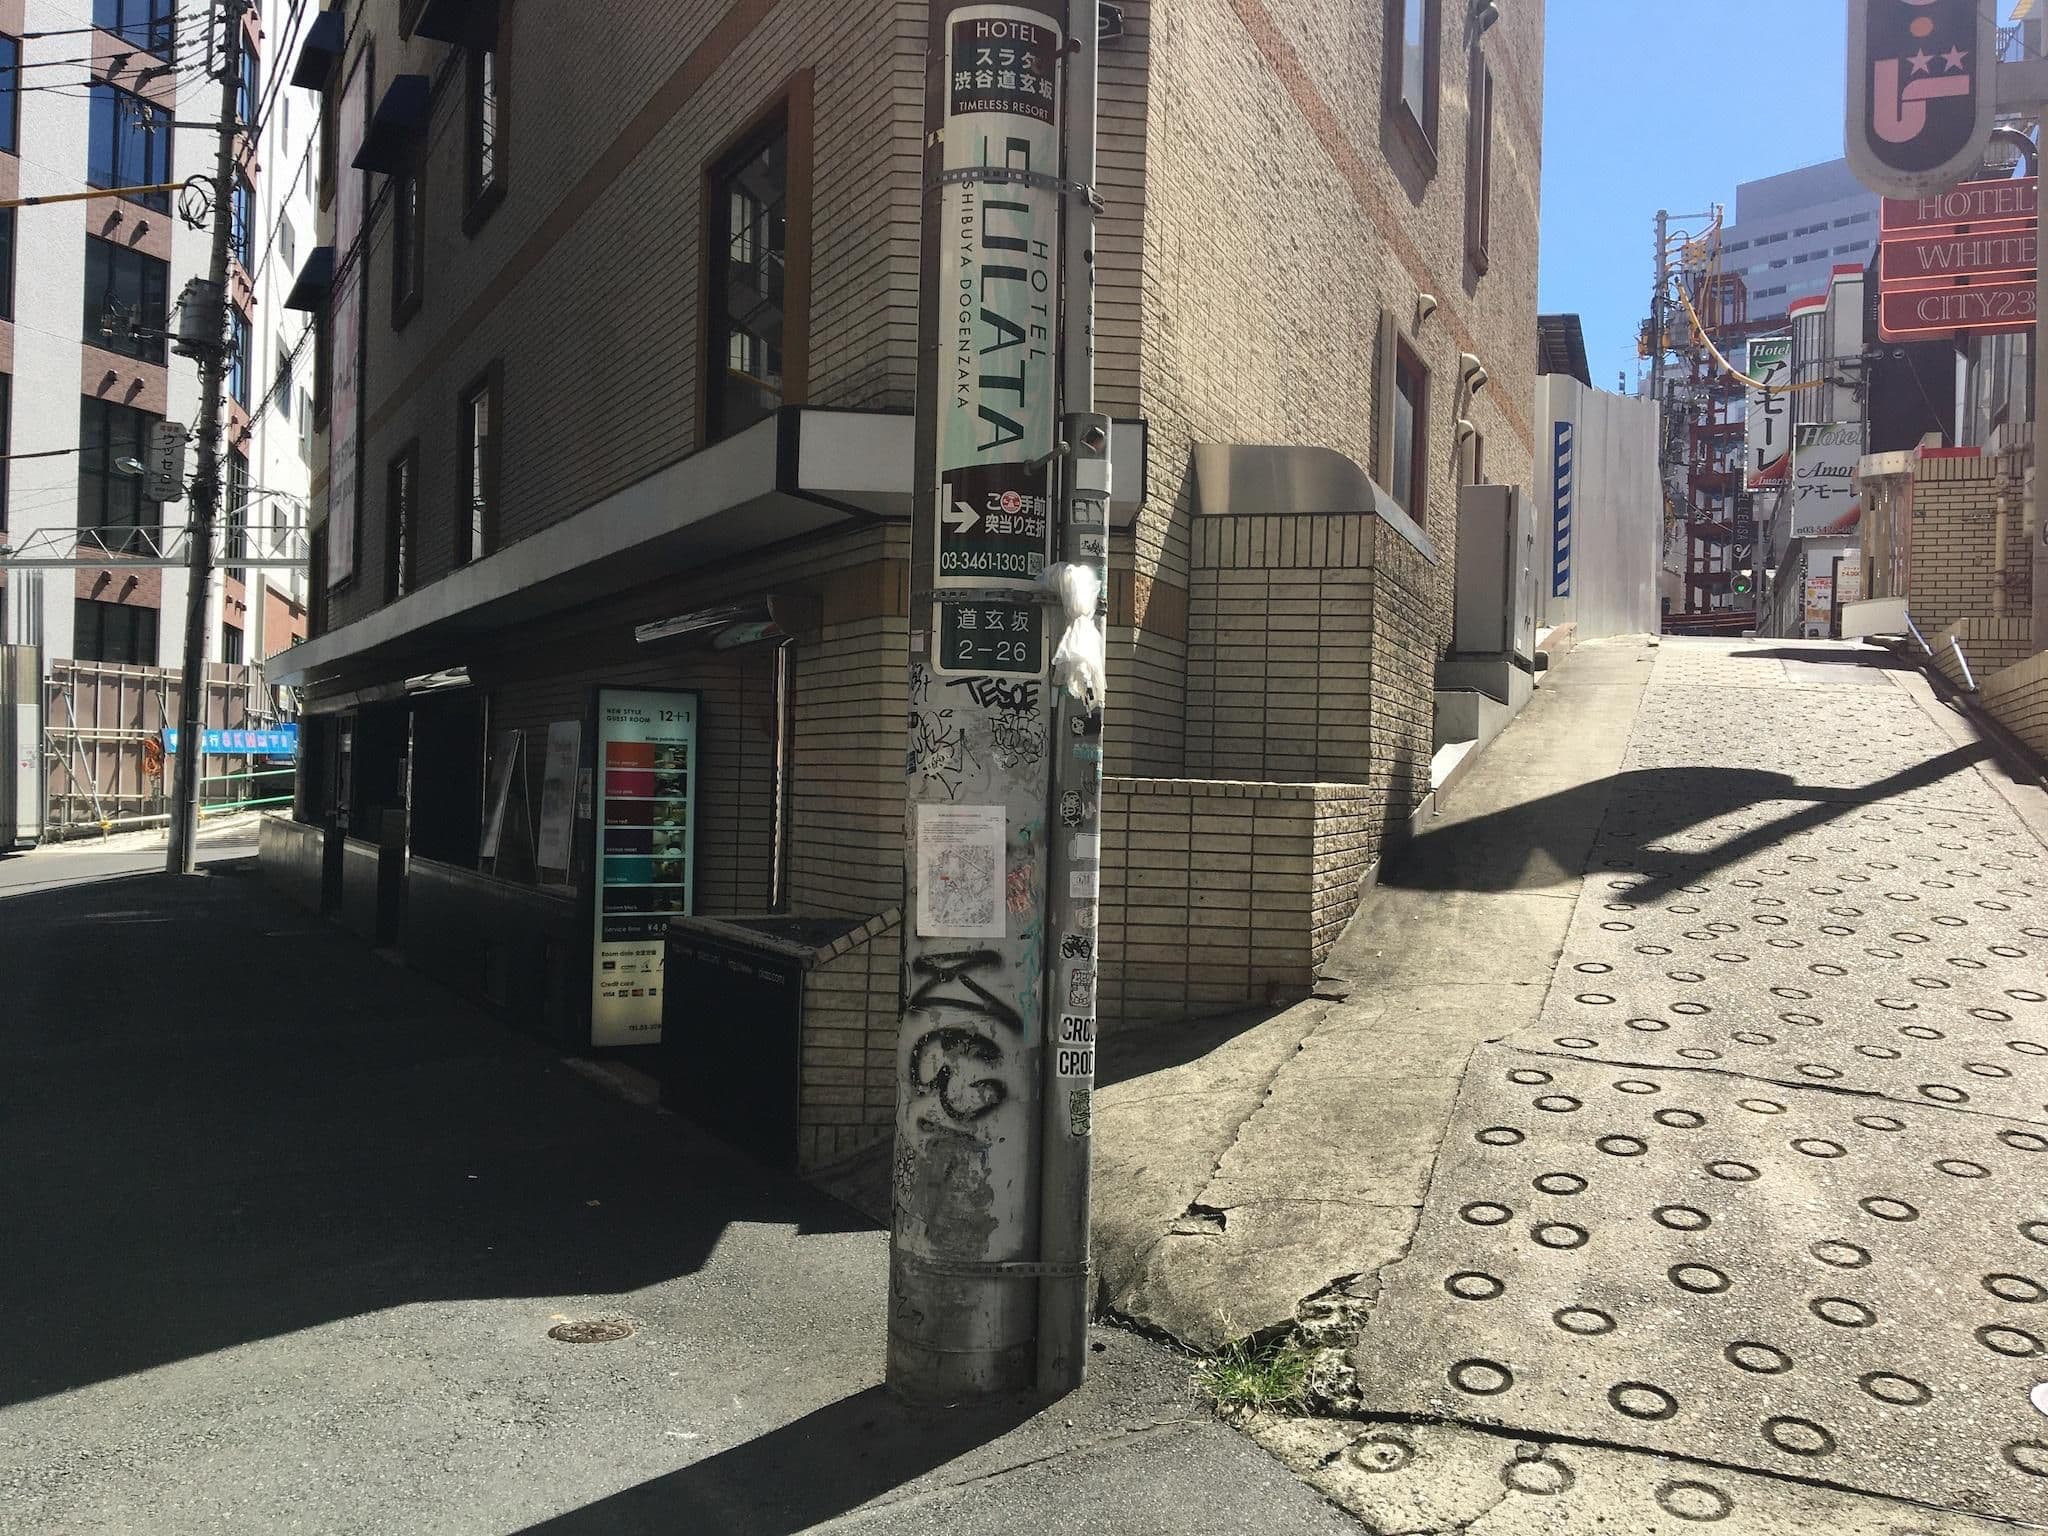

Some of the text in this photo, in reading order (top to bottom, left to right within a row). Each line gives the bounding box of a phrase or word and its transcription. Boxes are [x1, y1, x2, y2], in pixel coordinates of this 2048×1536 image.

[976, 21, 1038, 45] HOTEL
[954, 69, 1055, 100] 渋谷道玄坂
[958, 99, 1049, 120] TIMELESS RESORT
[1916, 187, 2034, 221] HOTEL
[1916, 237, 2037, 271] WHITE
[956, 180, 975, 409] SHIBUYA DOGENZAKA
[1029, 239, 1049, 360] HOTEL
[1917, 290, 2036, 322] CITY23
[1752, 344, 1791, 357] Hotel
[1754, 359, 1788, 472] アモーレ
[1797, 461, 1855, 478] Amor
[986, 492, 1046, 517] こ手前
[984, 513, 1046, 539] 突当り左折
[941, 551, 1026, 572] 03-3461-1303
[956, 609, 1030, 633] 道玄坂
